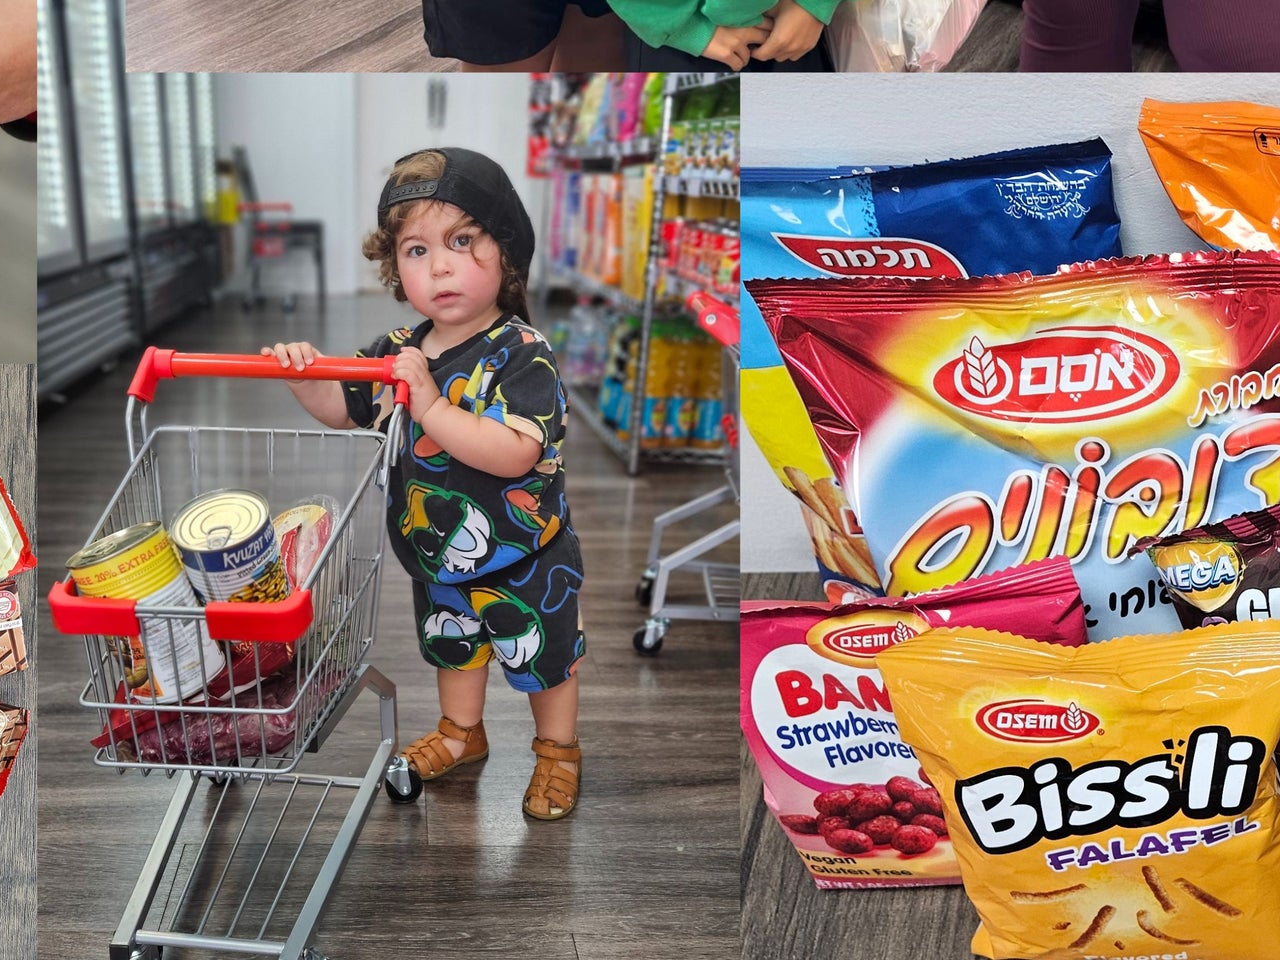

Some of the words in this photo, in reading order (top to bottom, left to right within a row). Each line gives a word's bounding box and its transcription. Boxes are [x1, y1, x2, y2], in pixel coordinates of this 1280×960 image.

[816, 247, 931, 269] תלמה
[94, 569, 118, 584] 20%
[117, 550, 155, 576] EXTRA
[222, 536, 264, 570] KVUZAT
[1158, 556, 1236, 592] MEGA
[839, 630, 889, 649] OSEM
[774, 669, 894, 718] BAM
[776, 710, 900, 750] Strawberr
[996, 711, 1058, 730] OSEM
[962, 728, 1261, 850] Bissli
[801, 851, 857, 866] Vegan
[1047, 816, 1260, 873] FALAFEL
[811, 863, 870, 877] Gluten
[873, 866, 914, 878] Free
